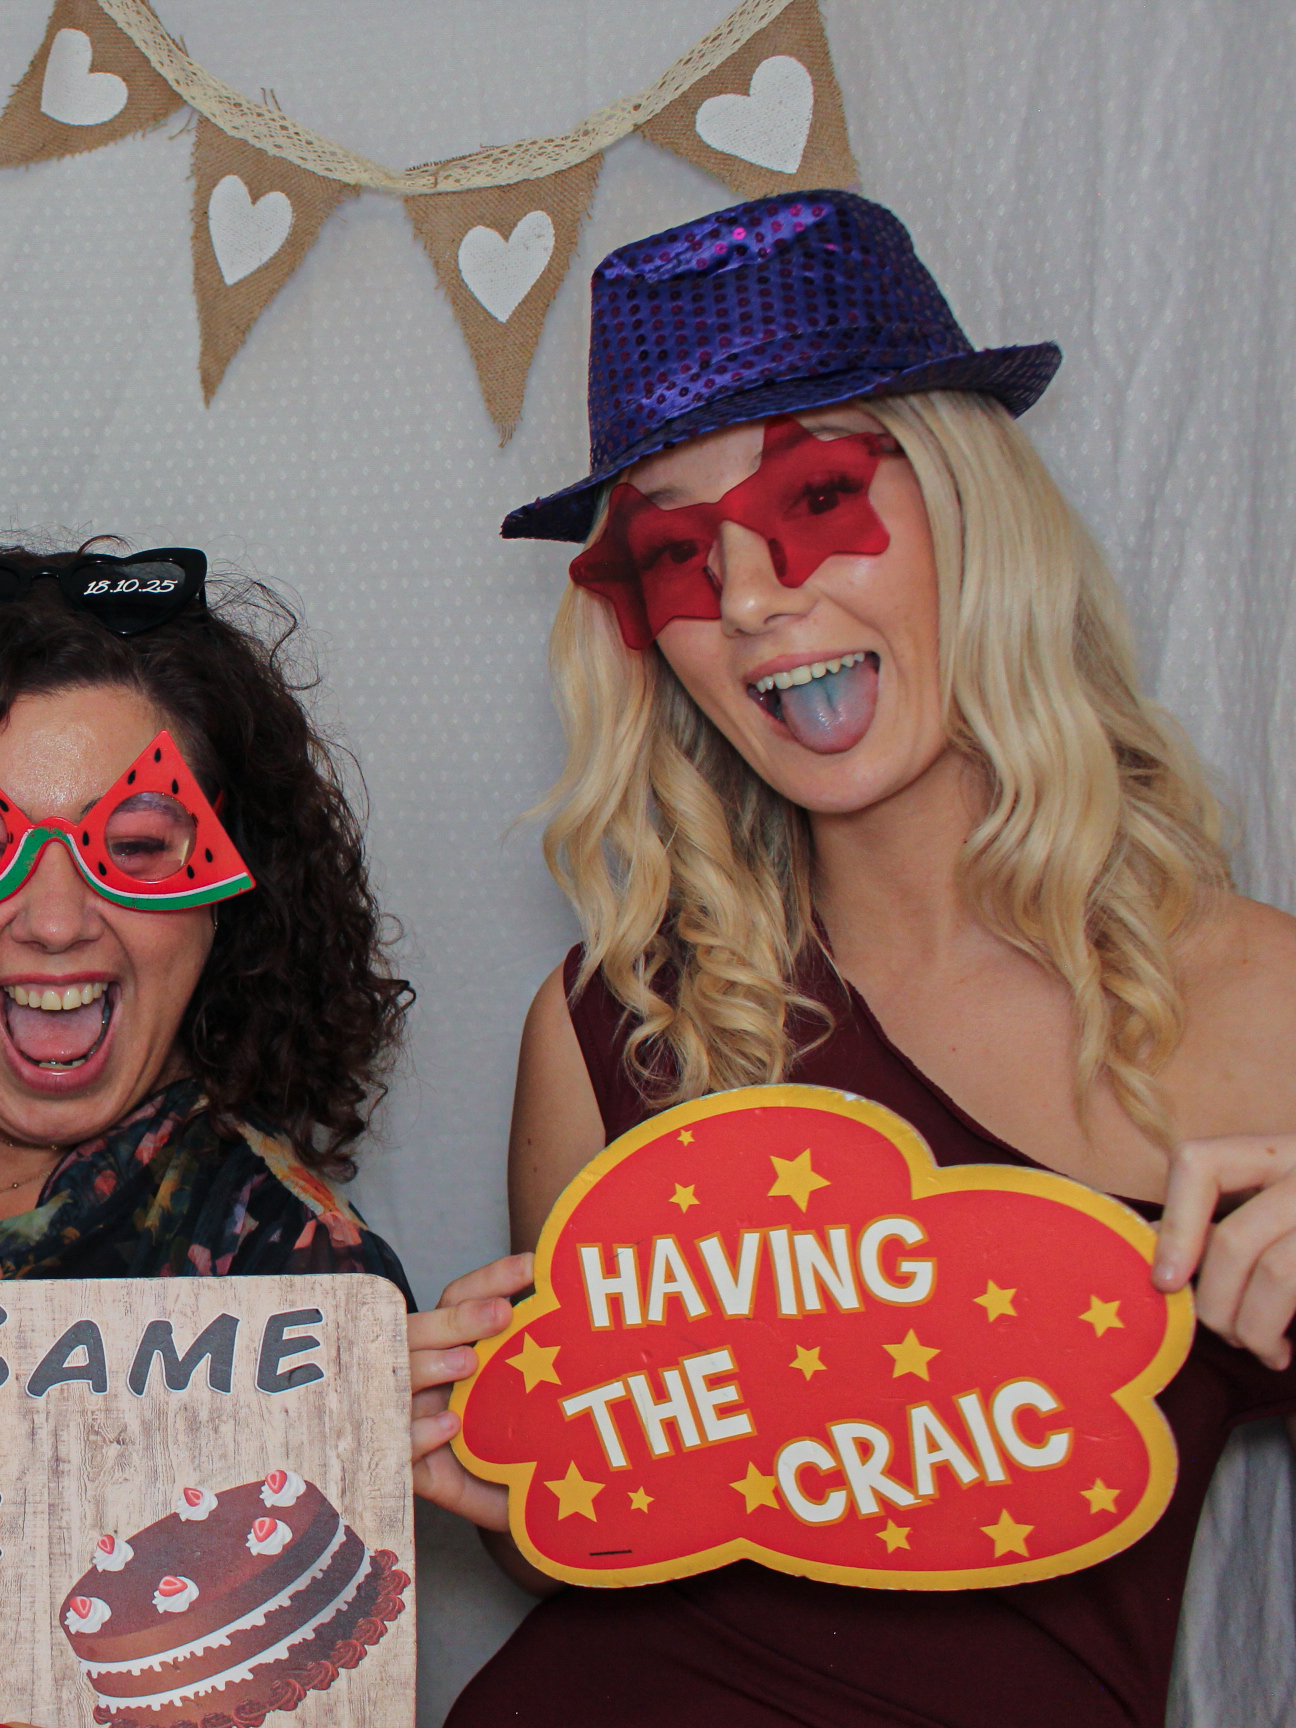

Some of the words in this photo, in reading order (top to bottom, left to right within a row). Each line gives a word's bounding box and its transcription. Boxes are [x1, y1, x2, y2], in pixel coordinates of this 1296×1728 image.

[83, 579, 178, 595] 18.10.25
[576, 1214, 936, 1332] HAVING
[560, 1345, 755, 1471] THE
[773, 1376, 1074, 1526] CRAIC
